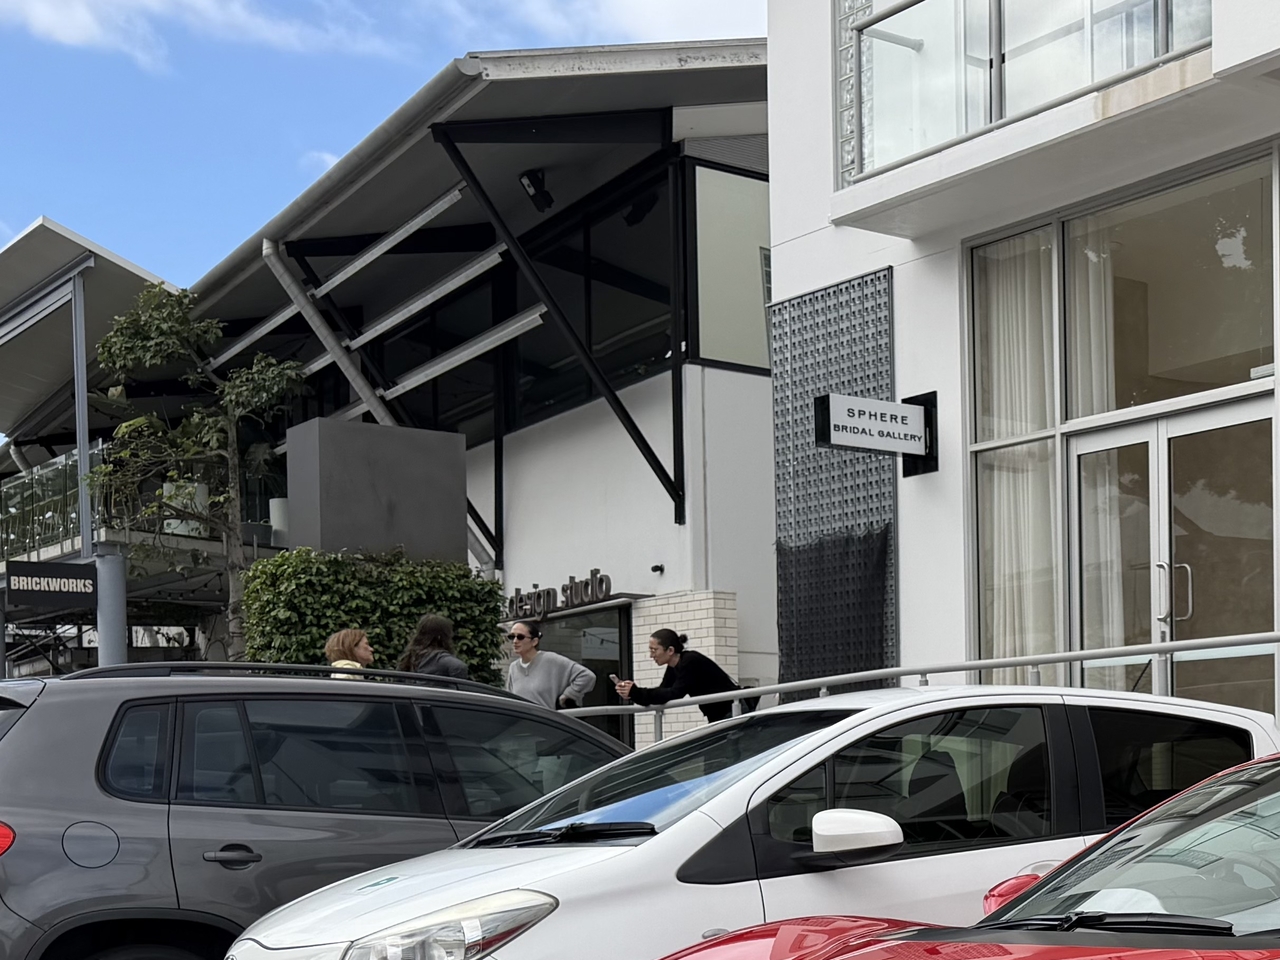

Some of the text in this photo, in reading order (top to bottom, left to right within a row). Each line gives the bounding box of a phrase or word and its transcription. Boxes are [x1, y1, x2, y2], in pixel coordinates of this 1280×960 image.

[847, 408, 908, 425] SPHERE
[833, 424, 923, 442] BRIDAL GALLERY
[10, 576, 93, 593] BRICKWORKS
[509, 568, 612, 620] design studio
